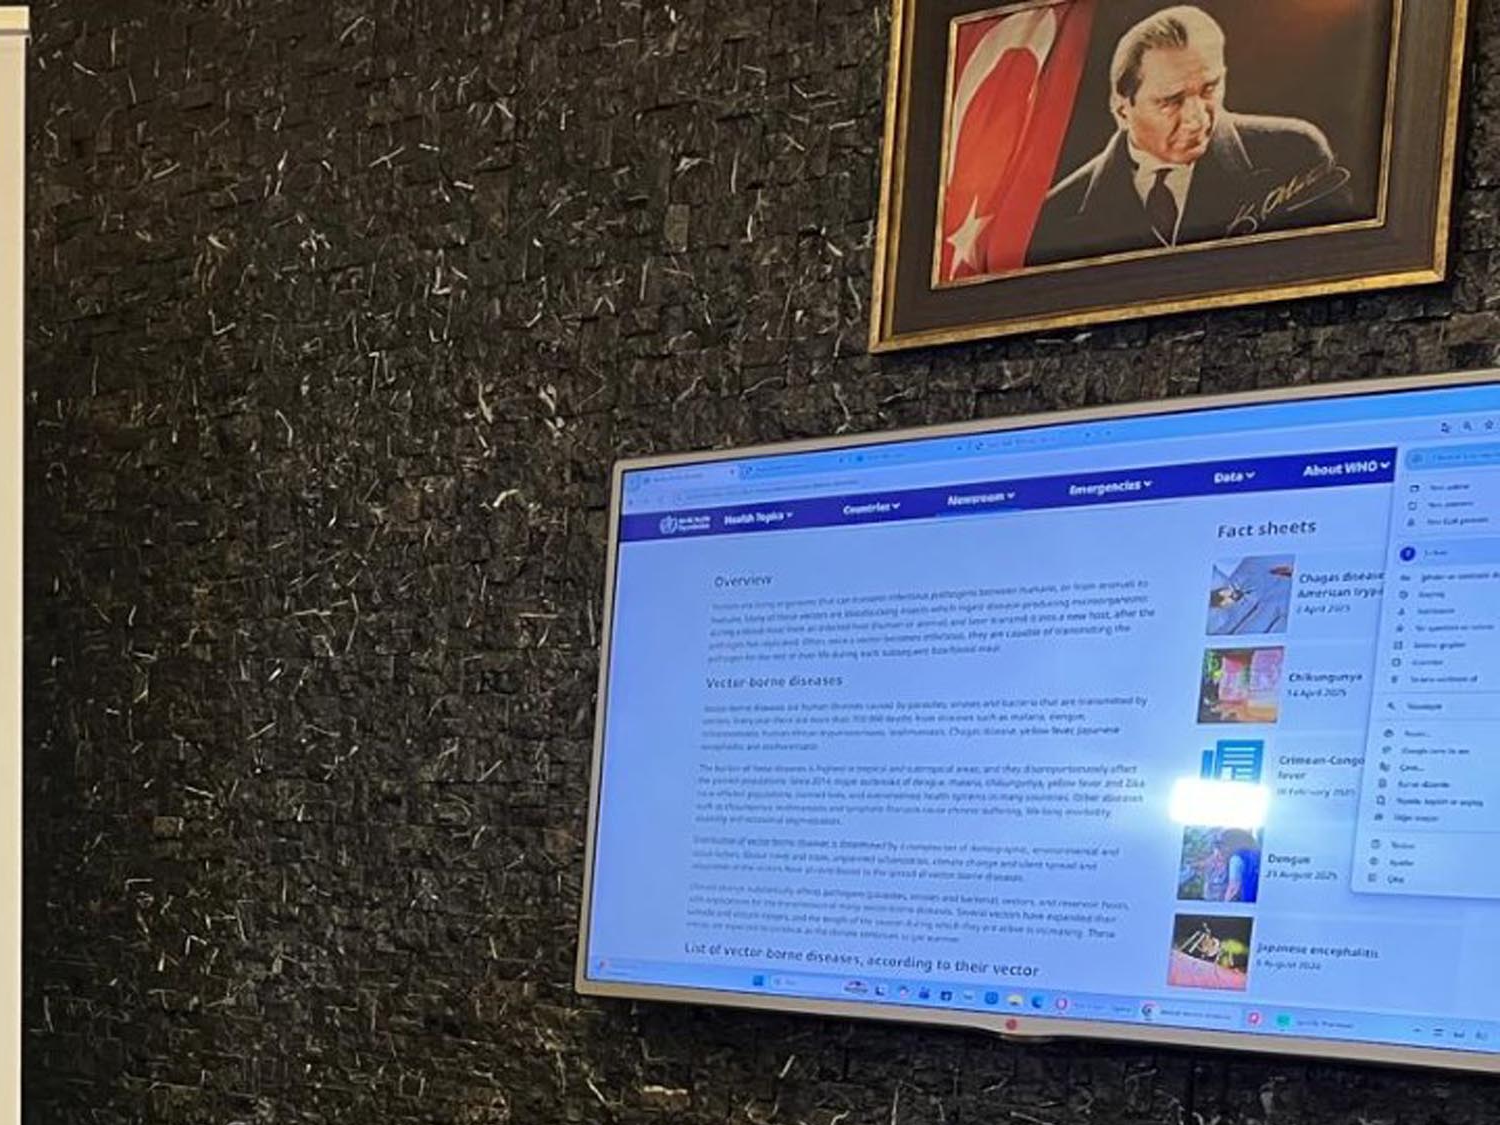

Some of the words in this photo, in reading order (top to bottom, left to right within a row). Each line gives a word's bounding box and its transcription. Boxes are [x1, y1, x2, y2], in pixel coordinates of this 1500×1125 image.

[1303, 464, 1344, 477] About
[1345, 460, 1379, 475] WHO
[1214, 471, 1243, 484] Data
[1069, 480, 1141, 495] Emergencies
[947, 491, 1005, 506] Newsroom
[843, 502, 890, 516] Countries
[1218, 523, 1253, 538] Fact
[1258, 520, 1317, 536] sheets
[714, 576, 774, 588] Overview
[1299, 573, 1340, 585] Chagas
[1342, 571, 1385, 582] disease
[1297, 588, 1351, 599] American
[789, 676, 843, 687] diseases
[1288, 672, 1363, 684] Chikungunya
[1279, 754, 1365, 768] Crimean-Congo
[1278, 770, 1306, 780] fever
[1267, 854, 1311, 867] Dengue
[1280, 870, 1314, 881] August
[1257, 942, 1309, 955] Japanese
[1310, 945, 1379, 959] encephalitis
[684, 942, 706, 955] List
[709, 943, 722, 956] of
[806, 951, 864, 967] diseases,
[866, 955, 933, 973] according
[936, 956, 951, 970] to
[954, 958, 989, 973] their
[992, 964, 1040, 977] vector
